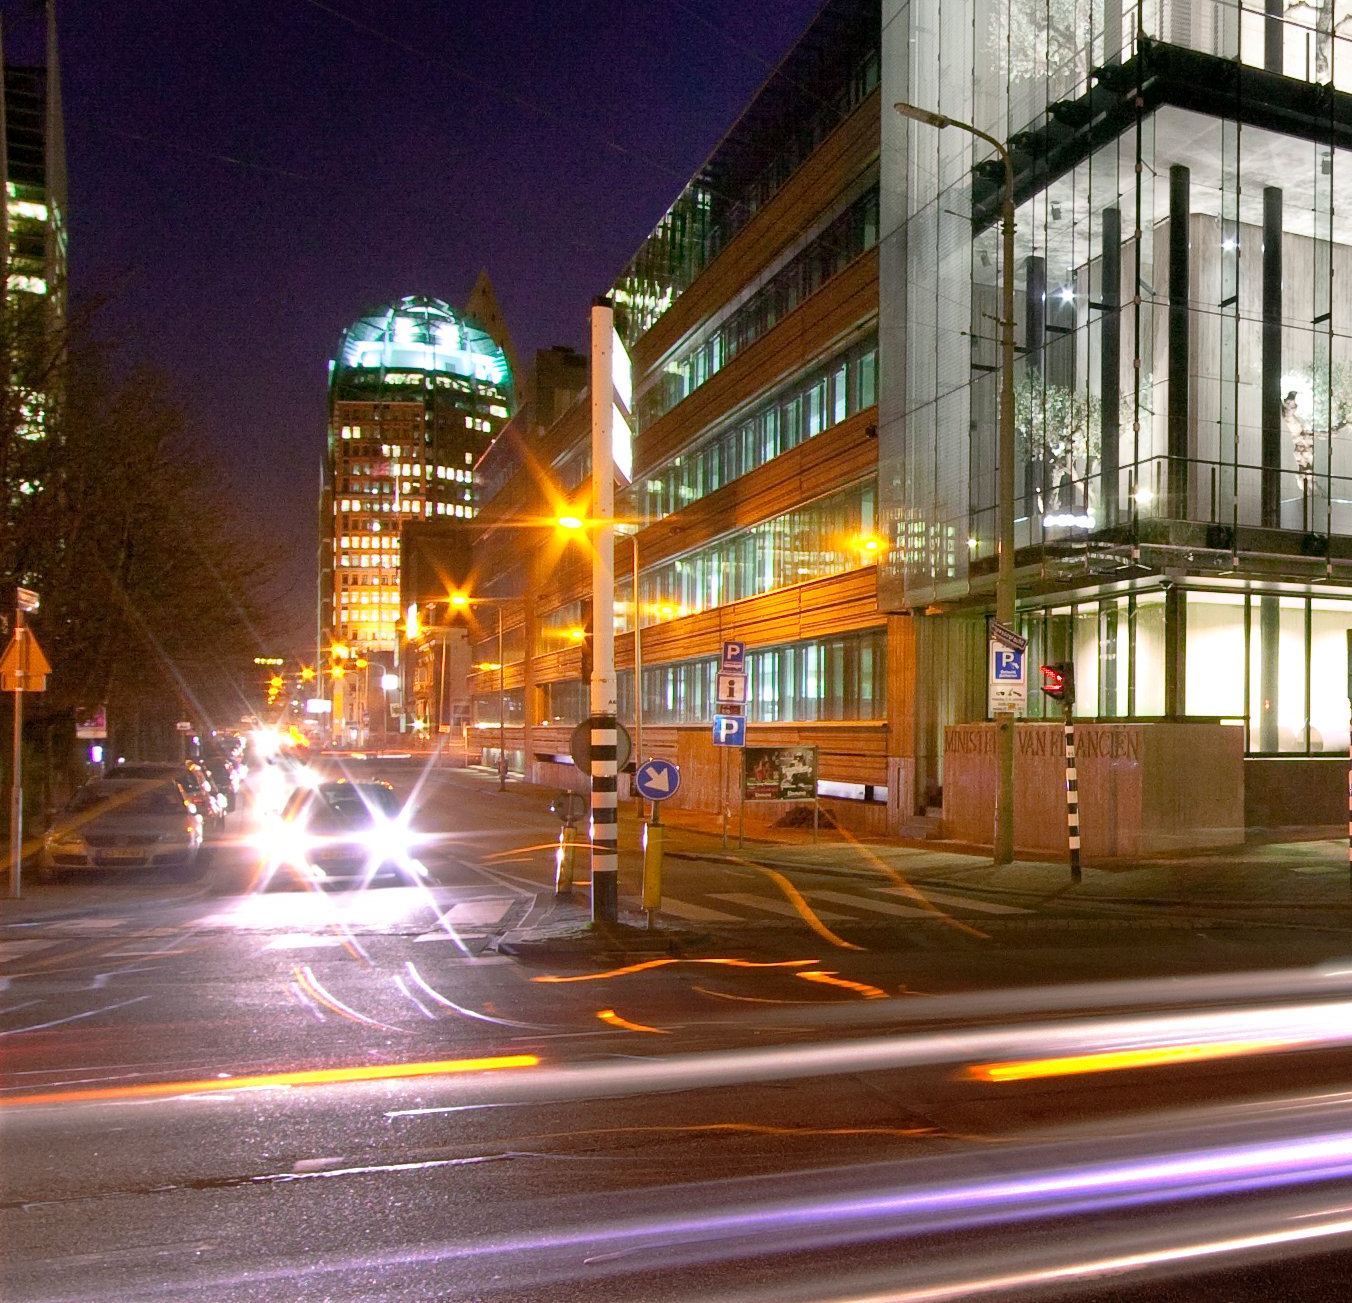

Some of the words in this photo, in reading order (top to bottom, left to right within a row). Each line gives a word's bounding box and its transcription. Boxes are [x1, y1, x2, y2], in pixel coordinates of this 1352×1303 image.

[727, 645, 740, 659] P
[1002, 652, 1014, 667] P
[720, 719, 738, 742] P
[1018, 731, 1046, 756] VAN
